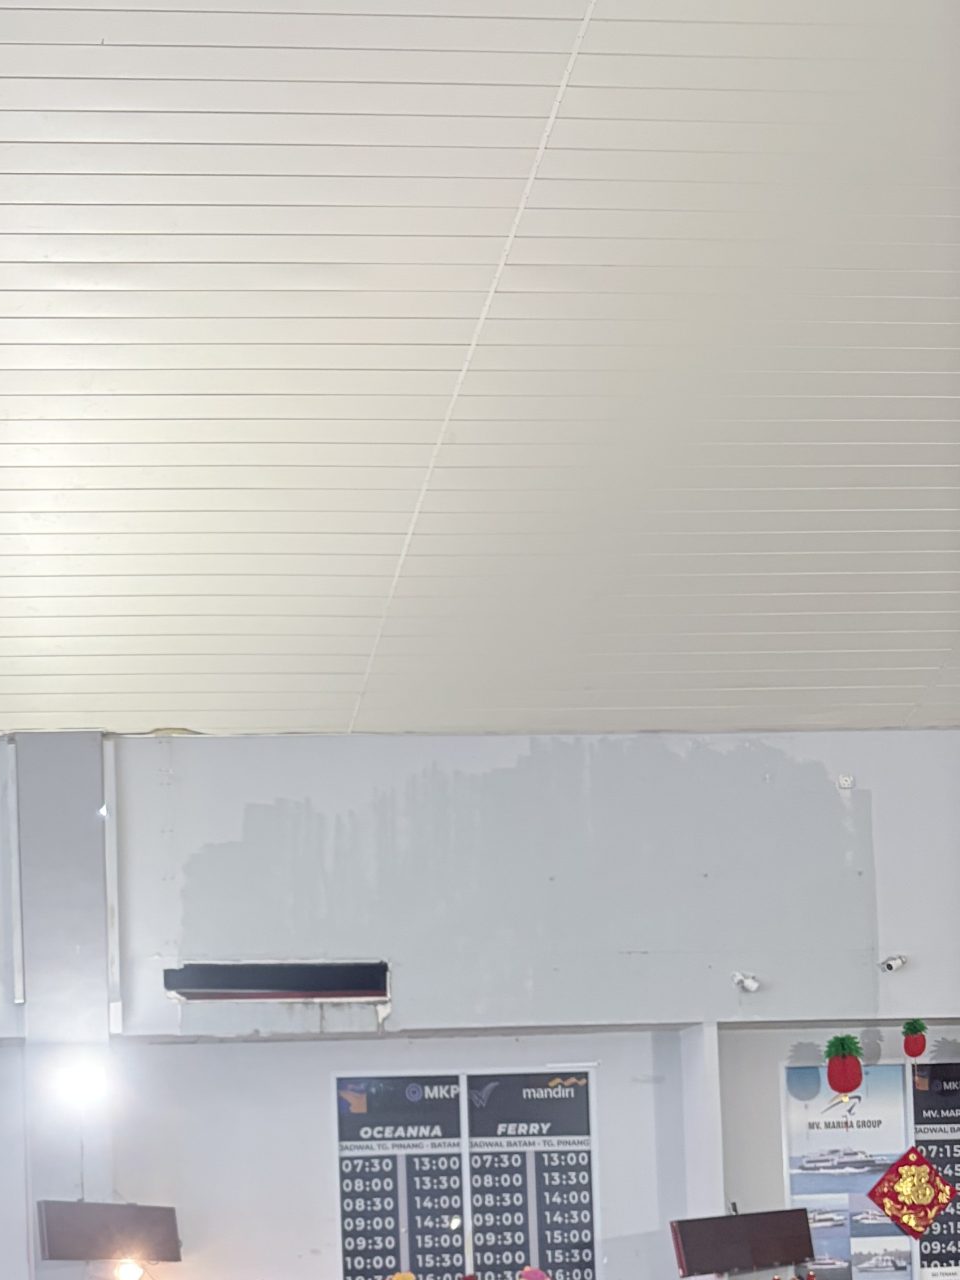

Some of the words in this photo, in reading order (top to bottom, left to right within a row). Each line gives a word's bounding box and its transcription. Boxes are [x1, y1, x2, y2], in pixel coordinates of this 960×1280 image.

[424, 1085, 460, 1099] MKP
[522, 1085, 575, 1099] mandiri
[497, 1123, 551, 1136] FERRY
[856, 1119, 882, 1129] GROUP
[360, 1125, 442, 1139] OCEANNA
[342, 1159, 392, 1172] 07:30
[413, 1157, 459, 1170] 13:00
[471, 1154, 521, 1168] 07:30
[543, 1153, 588, 1166] 13:00
[343, 1178, 393, 1192] 08:00
[414, 1176, 460, 1189] 13:30
[470, 1174, 522, 1187] 08:00
[543, 1172, 588, 1185] 13:30
[415, 1196, 460, 1208] 14:00
[471, 1193, 523, 1207] 08:30
[544, 1191, 589, 1204] 14:00
[343, 1198, 394, 1211] 08:30
[472, 1212, 523, 1226] 09:00
[545, 1210, 590, 1223] 14:30
[344, 1217, 395, 1230] 09:00
[345, 1236, 395, 1250] 09:30
[416, 1234, 462, 1248] 15:00
[474, 1232, 524, 1245] 09:30
[545, 1230, 591, 1243] 15:00
[346, 1256, 396, 1269] 10:00
[417, 1254, 463, 1267] 15:30
[475, 1251, 527, 1265] 10:00
[546, 1249, 592, 1263] 15:30
